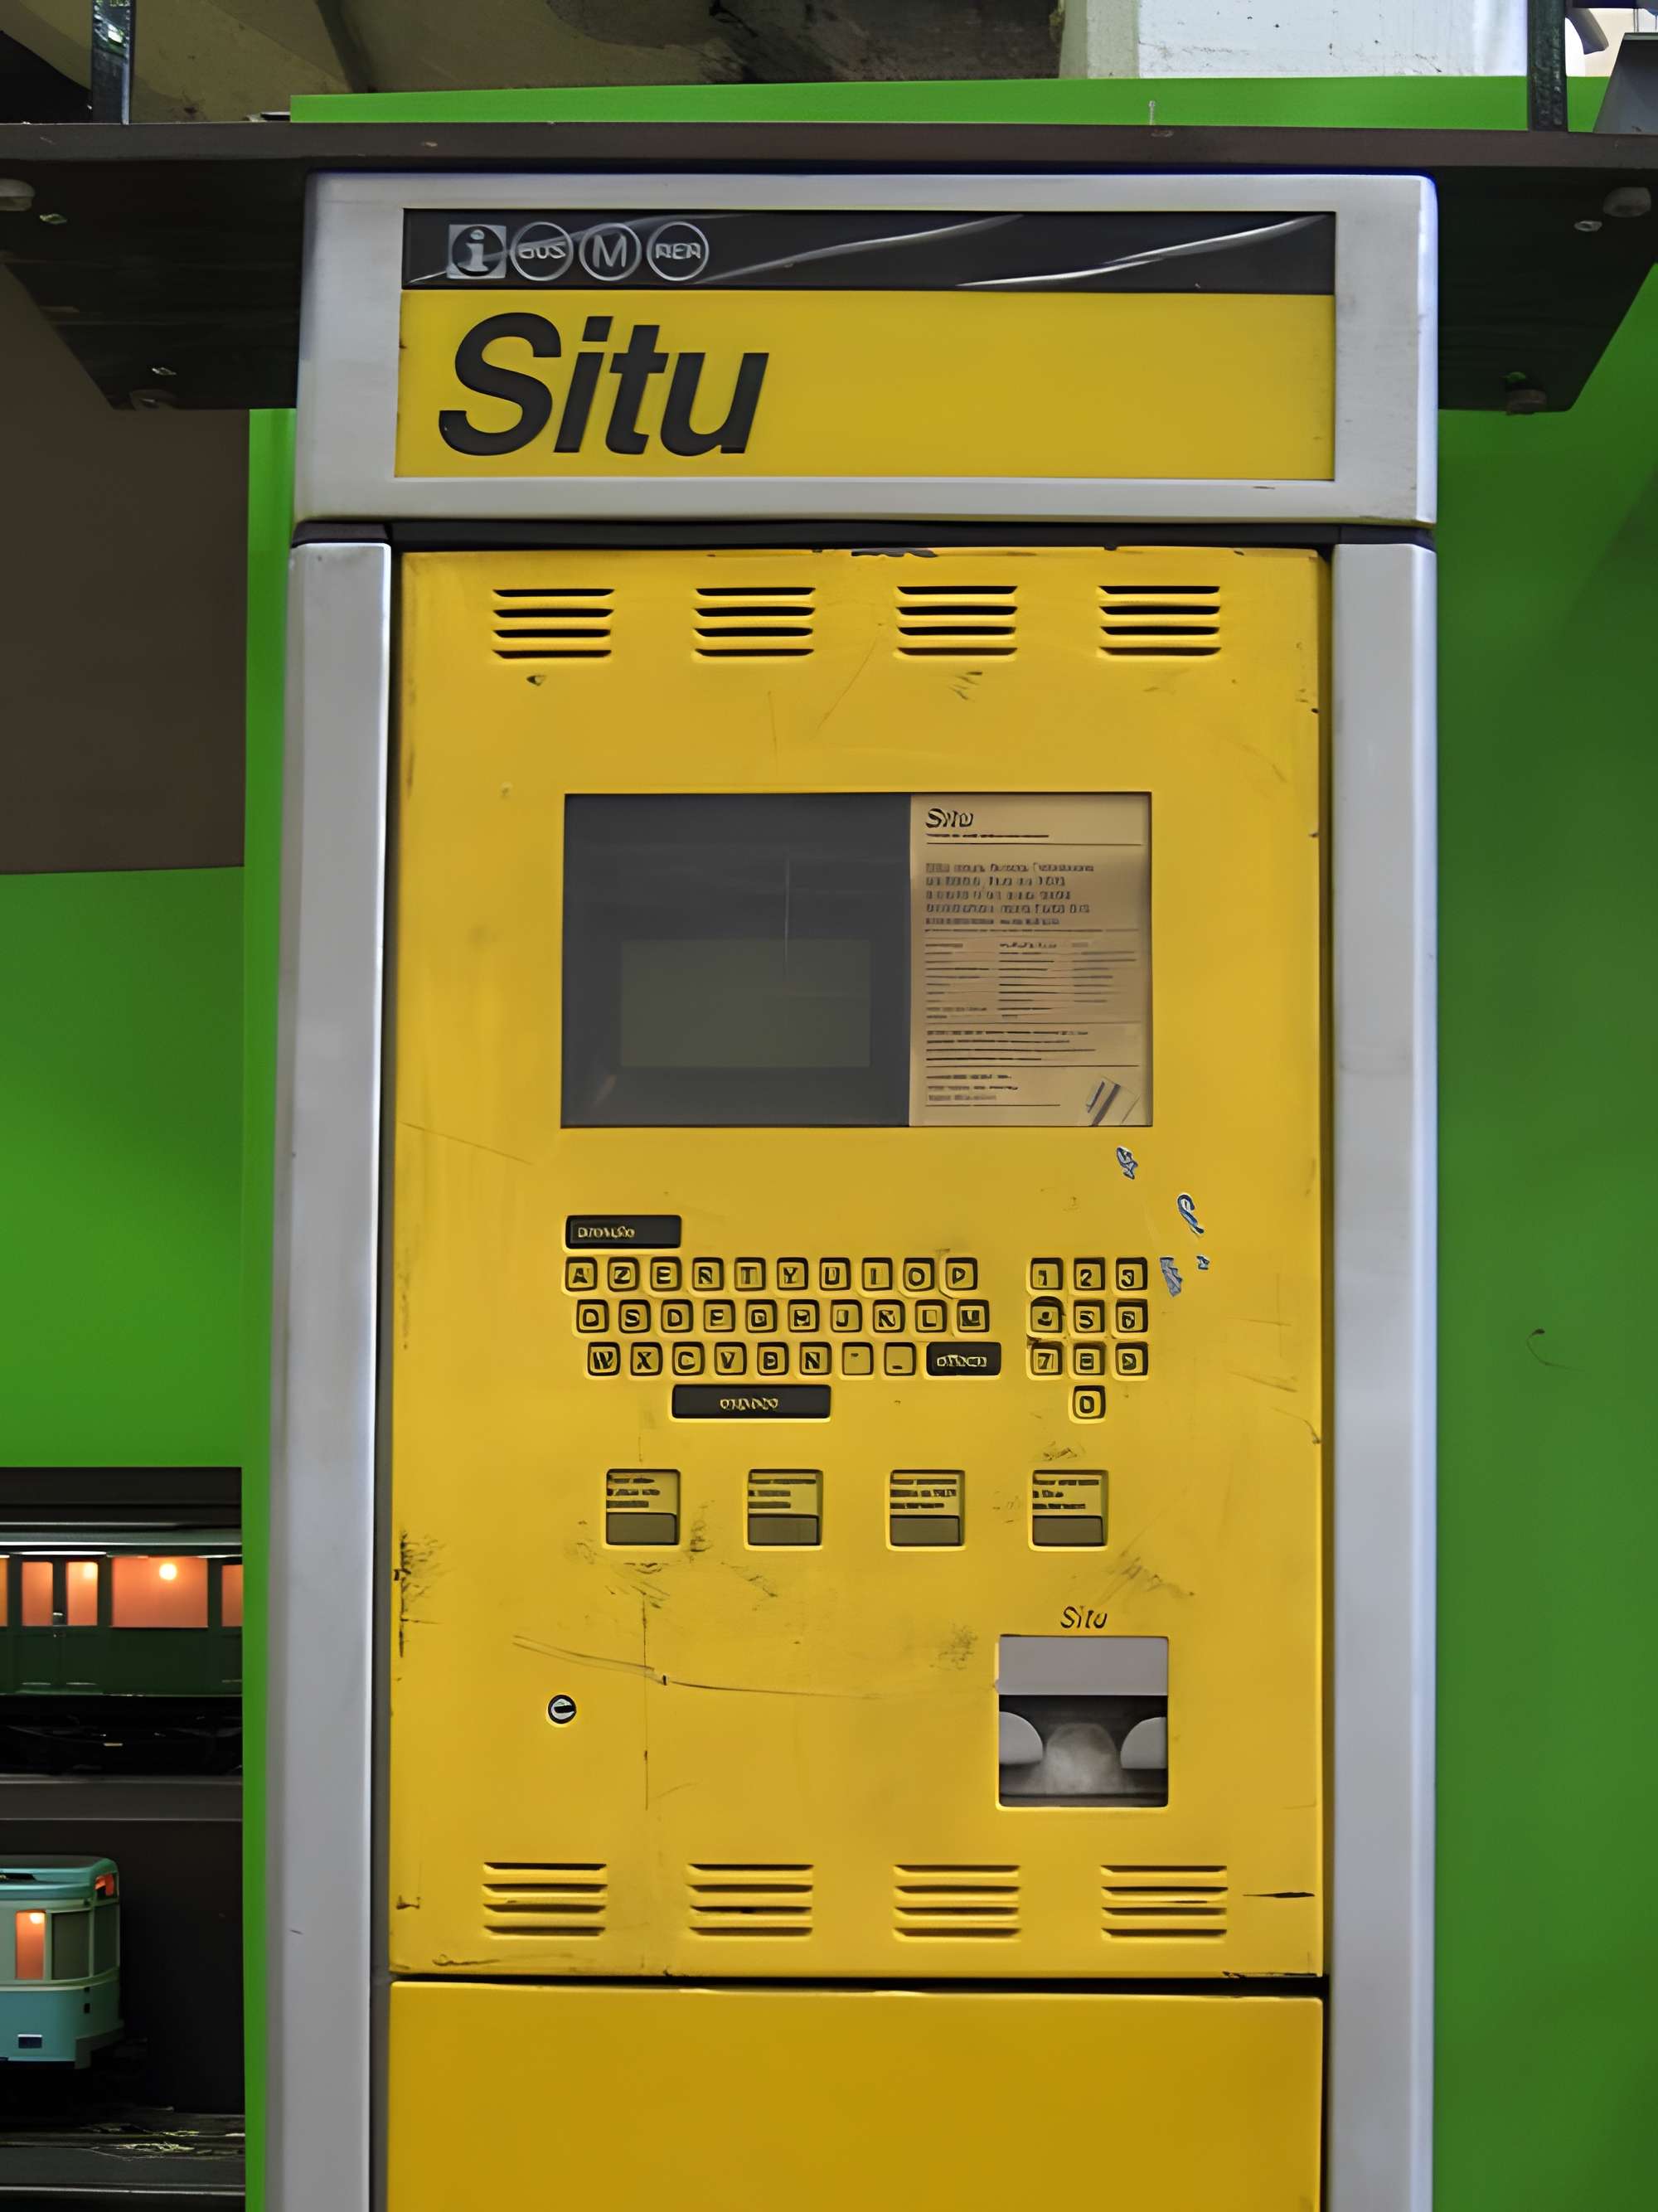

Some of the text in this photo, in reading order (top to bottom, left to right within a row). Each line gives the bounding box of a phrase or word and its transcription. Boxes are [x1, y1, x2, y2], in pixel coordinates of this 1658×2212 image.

[593, 234, 627, 269] M
[439, 313, 769, 457] Situ
[657, 1267, 671, 1284] E
[741, 1267, 757, 1284] T
[783, 1267, 798, 1283] Y
[1080, 1269, 1092, 1287] 2
[638, 1351, 652, 1370] X
[678, 1351, 695, 1370] C
[720, 1351, 735, 1369] V
